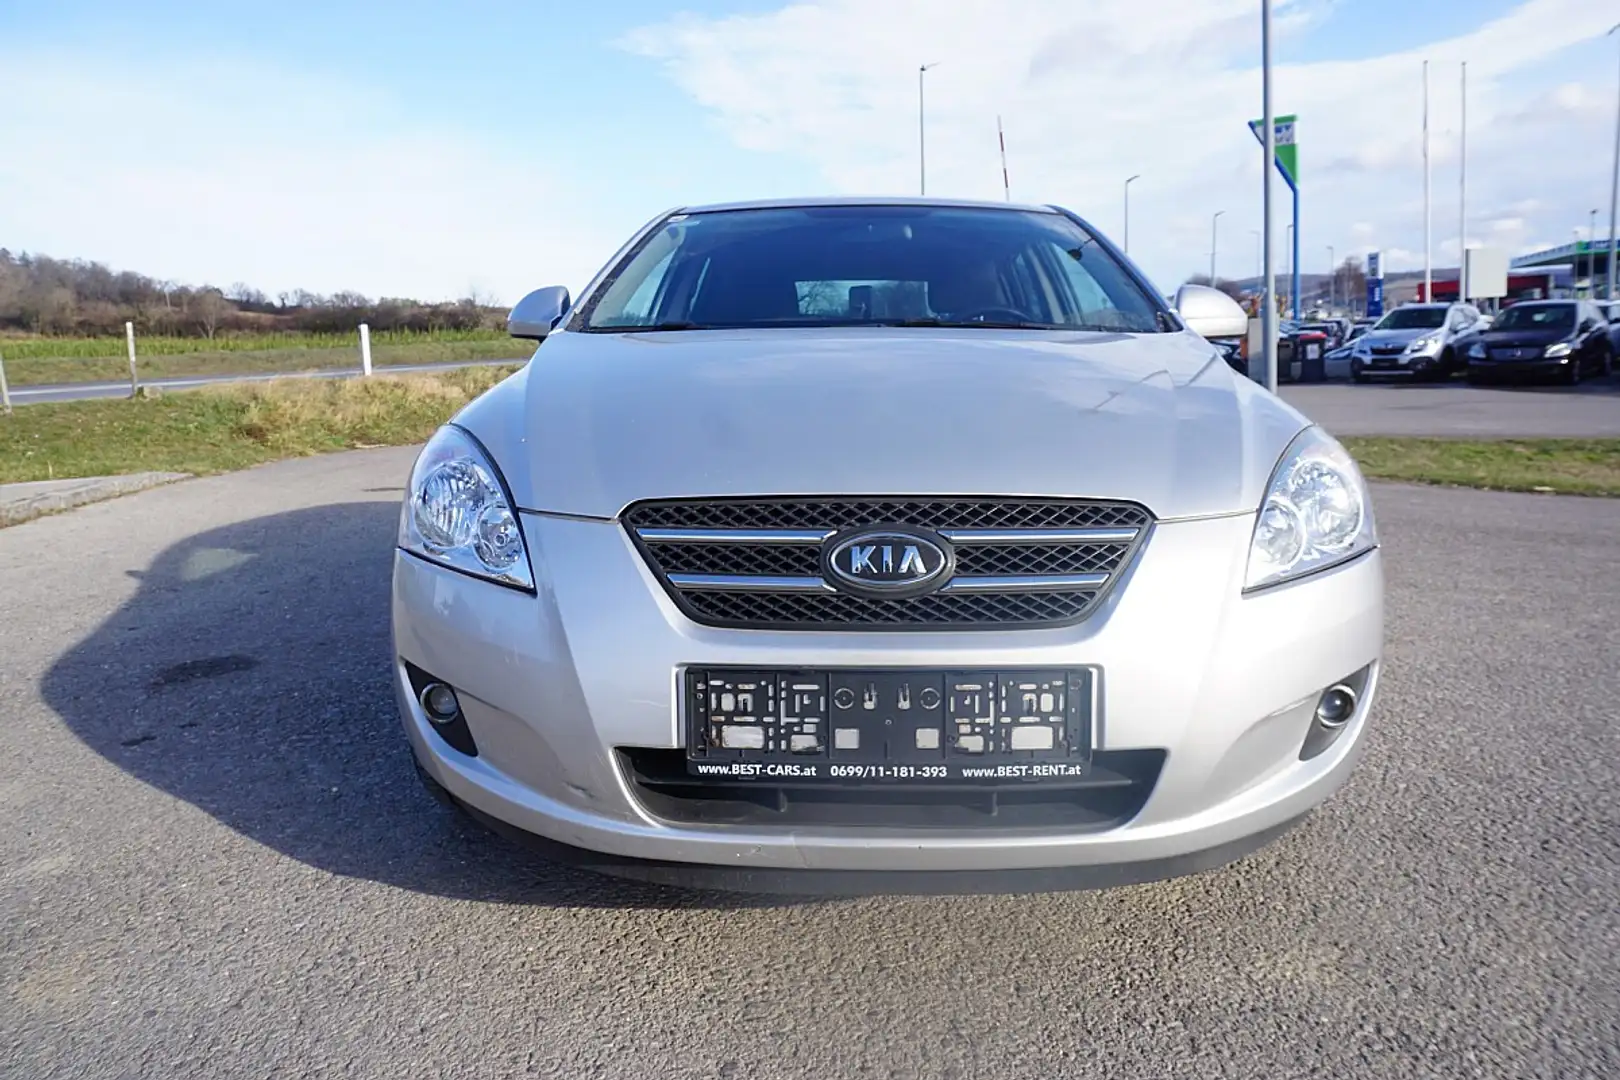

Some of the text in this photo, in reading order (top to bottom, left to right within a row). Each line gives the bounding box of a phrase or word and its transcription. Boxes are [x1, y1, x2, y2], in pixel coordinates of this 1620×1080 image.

[850, 545, 927, 574] KIA
[698, 764, 1082, 778] www.BEST-CARS.at 0699/11-181-393 www.BEST-RENT.at
